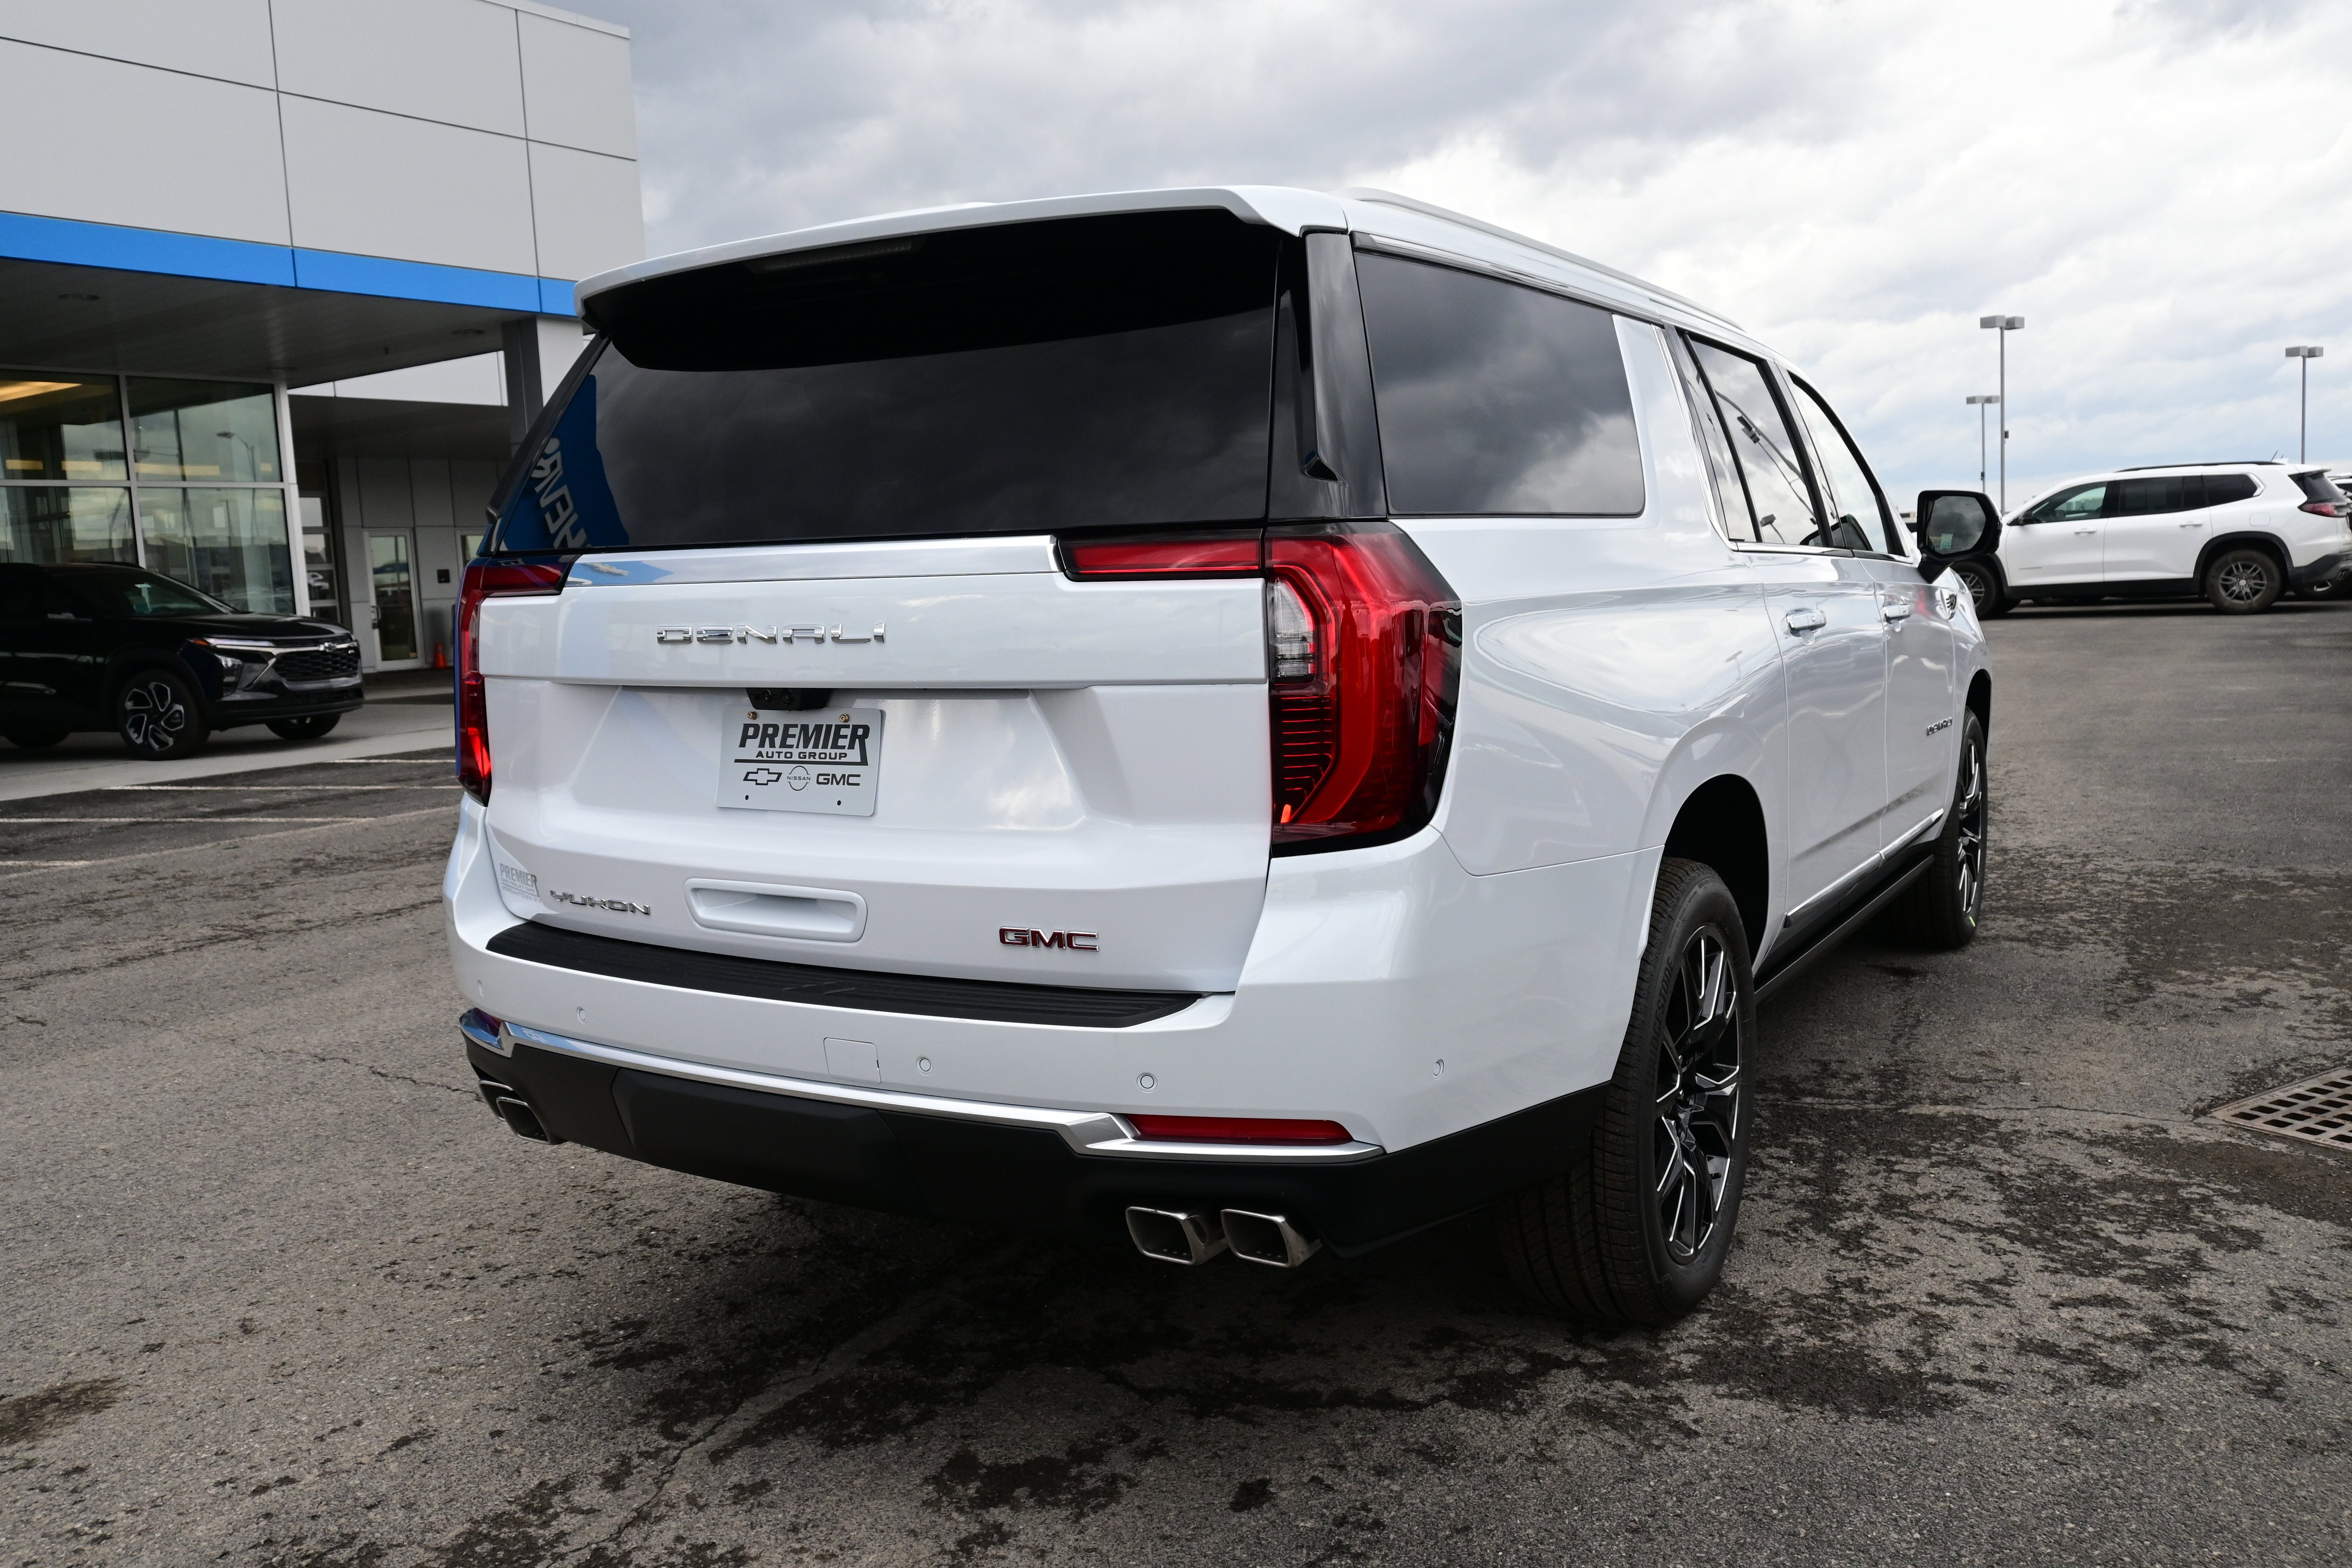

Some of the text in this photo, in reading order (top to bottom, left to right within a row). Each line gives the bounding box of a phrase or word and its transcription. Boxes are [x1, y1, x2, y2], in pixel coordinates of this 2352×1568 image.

[657, 623, 885, 645] DENALI
[738, 723, 870, 750] PREMIER
[755, 751, 848, 760] AUTO GROUP
[816, 773, 861, 786] GMC
[500, 863, 537, 888] PREMIER
[550, 890, 651, 915] YUKON
[999, 926, 1099, 951] GMC
